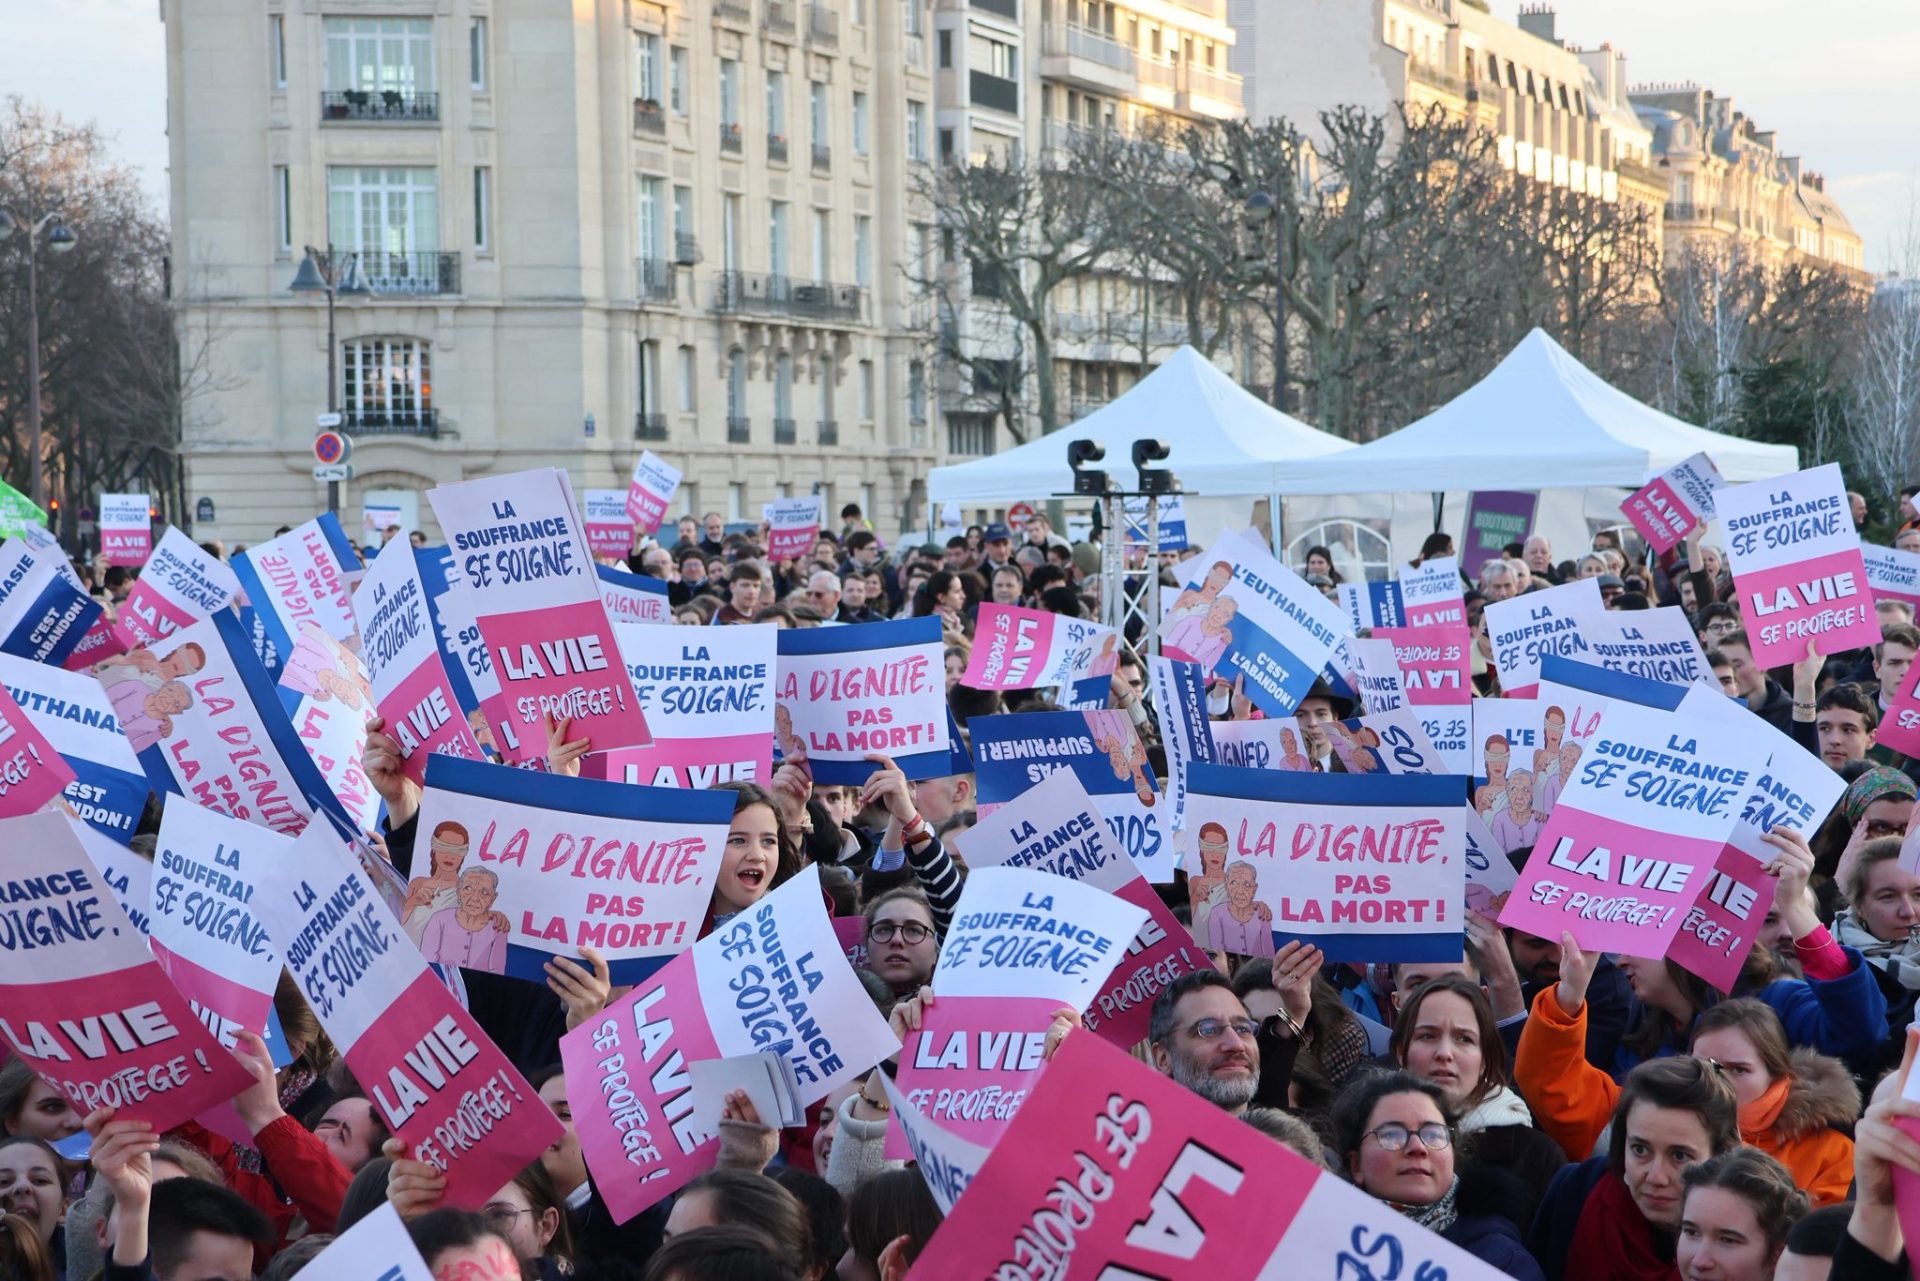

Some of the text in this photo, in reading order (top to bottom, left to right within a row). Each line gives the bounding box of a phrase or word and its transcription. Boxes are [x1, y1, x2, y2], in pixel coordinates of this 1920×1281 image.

[492, 500, 517, 520] LA
[631, 489, 644, 504] LA
[642, 496, 662, 516] VIE
[1646, 488, 1689, 534] LA VIE
[1769, 490, 1793, 505] LA
[1474, 511, 1526, 533] BOUTIQUE
[1727, 495, 1841, 532] SOUFFRANCE
[106, 536, 146, 547] LA VIE
[454, 517, 568, 551] SOUFFRANCE
[591, 530, 630, 540] LA VIE
[774, 533, 812, 546] LA VIE
[1732, 530, 1759, 557] SE
[151, 558, 172, 576] SE
[160, 548, 229, 599] SOUFFRANCE
[191, 558, 205, 573] LA
[307, 543, 343, 596] MORT
[465, 552, 493, 589] SE
[1424, 567, 1435, 575] LA
[1864, 558, 1917, 574] SOUFFRANCE
[1885, 555, 1896, 564] LA
[303, 568, 326, 600] PAS
[373, 581, 387, 606] LA
[1404, 572, 1456, 586] SOUFFRANCE
[1404, 585, 1418, 598] SE
[1751, 571, 1858, 617] LA VIE
[132, 596, 158, 626] LA
[363, 578, 418, 650] SOUFFRANCE
[1232, 563, 1335, 648] L'EUTHANASIE
[1412, 608, 1462, 628] LA VIE
[1531, 605, 1554, 621] LA
[29, 607, 61, 645] C'EST
[995, 613, 1012, 633] SE
[1496, 616, 1577, 648] SOUFFRAN
[1621, 627, 1643, 640] LA
[1759, 625, 1783, 646] SE
[499, 634, 609, 681] LA VIE
[681, 646, 711, 661] LA
[1001, 618, 1039, 686] LA VIE
[1443, 646, 1461, 662] SE
[1499, 646, 1528, 673] SE
[1594, 640, 1694, 657] SOUFFRANCE
[1229, 651, 1292, 707] L'ABANDON
[1256, 652, 1290, 682] C'EST
[1426, 669, 1461, 689] LA
[194, 677, 235, 717] LA
[517, 696, 538, 724] SE
[299, 706, 330, 739] LA
[407, 686, 453, 741] VIE
[847, 707, 894, 727] PAS
[810, 724, 923, 752] LA MORT
[993, 736, 1095, 763] SUPPRIMER
[1666, 734, 1697, 755] LA
[169, 739, 201, 782] LA
[1580, 759, 1626, 789] SE
[1595, 740, 1749, 787] SOUFFRANCE
[478, 820, 530, 868] LA
[1009, 820, 1037, 845] LA
[1237, 817, 1277, 859] LA
[213, 843, 241, 872] LA
[1548, 836, 1695, 893] LA VIE
[103, 866, 130, 895] LA
[155, 876, 185, 914] SE
[1334, 875, 1391, 894] PAS
[1530, 880, 1569, 905] SE
[292, 880, 318, 912] LA
[585, 892, 645, 918] PAS
[1021, 891, 1055, 912] LA
[1281, 898, 1430, 923] LA MORT
[286, 873, 367, 972] SOUFFRANCE
[521, 911, 675, 949] LA MORT
[956, 912, 1113, 956] SOUFFRANCE
[719, 921, 756, 963] SE
[941, 935, 974, 970] SE
[795, 951, 825, 994] LA
[303, 967, 334, 1019] SE
[756, 903, 844, 1078] SOUFFRANCE
[0, 1000, 180, 1062] LA VIE
[592, 1019, 621, 1053] SE
[632, 984, 674, 1063] LA
[912, 1031, 1049, 1072] LA VIE
[372, 1013, 480, 1130] LA VIE
[1095, 1092, 1153, 1170] SE
[414, 1137, 448, 1173] SE
[1125, 1136, 1245, 1261] LA
